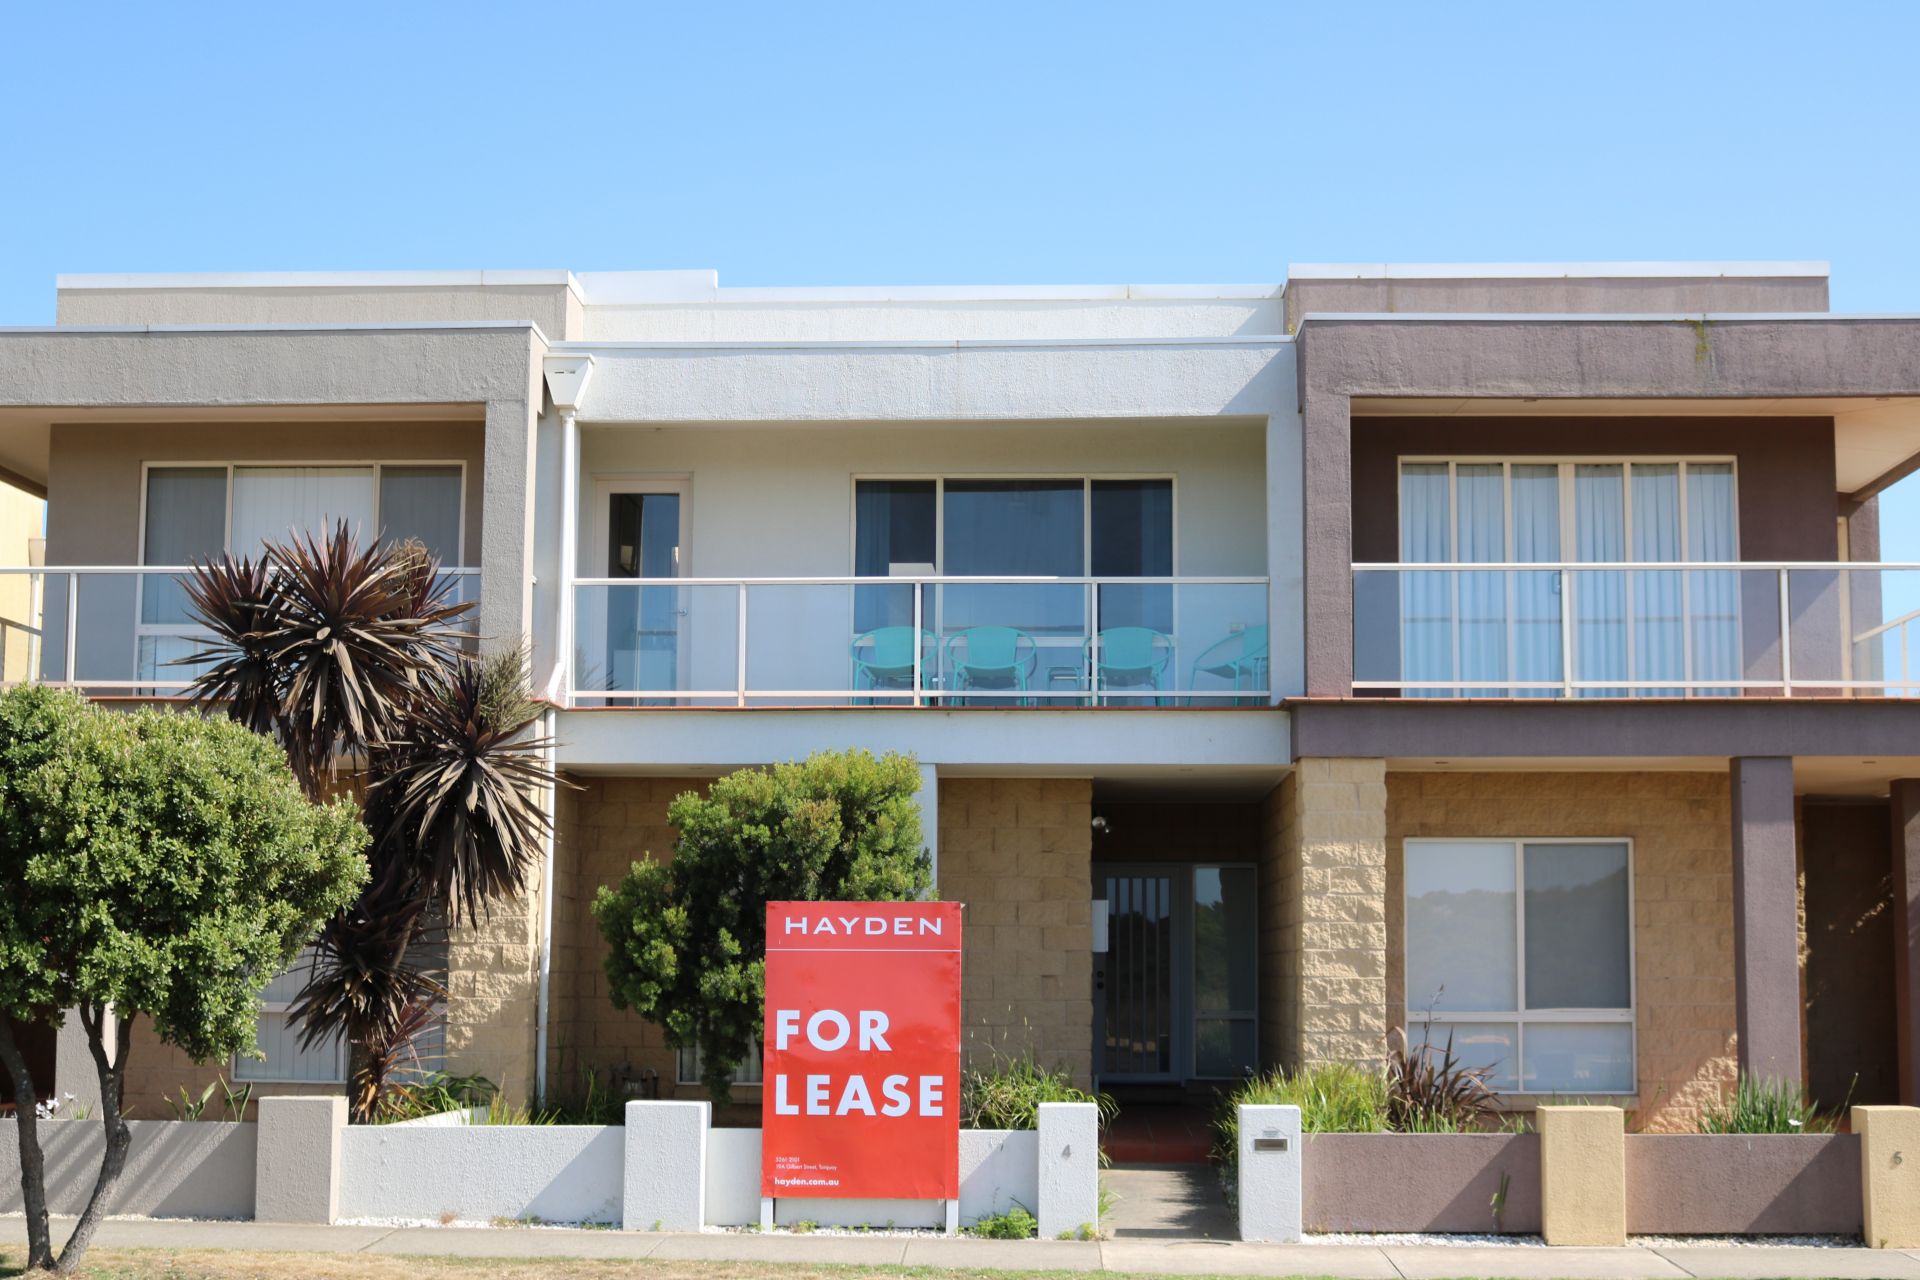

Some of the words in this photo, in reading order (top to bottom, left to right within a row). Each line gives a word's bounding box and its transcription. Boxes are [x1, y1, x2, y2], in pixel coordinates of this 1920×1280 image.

[785, 917, 942, 936] HAYDEN
[776, 1009, 893, 1052] FOR
[775, 1074, 944, 1117] LEASE
[774, 1177, 840, 1187] hayden.com.au
